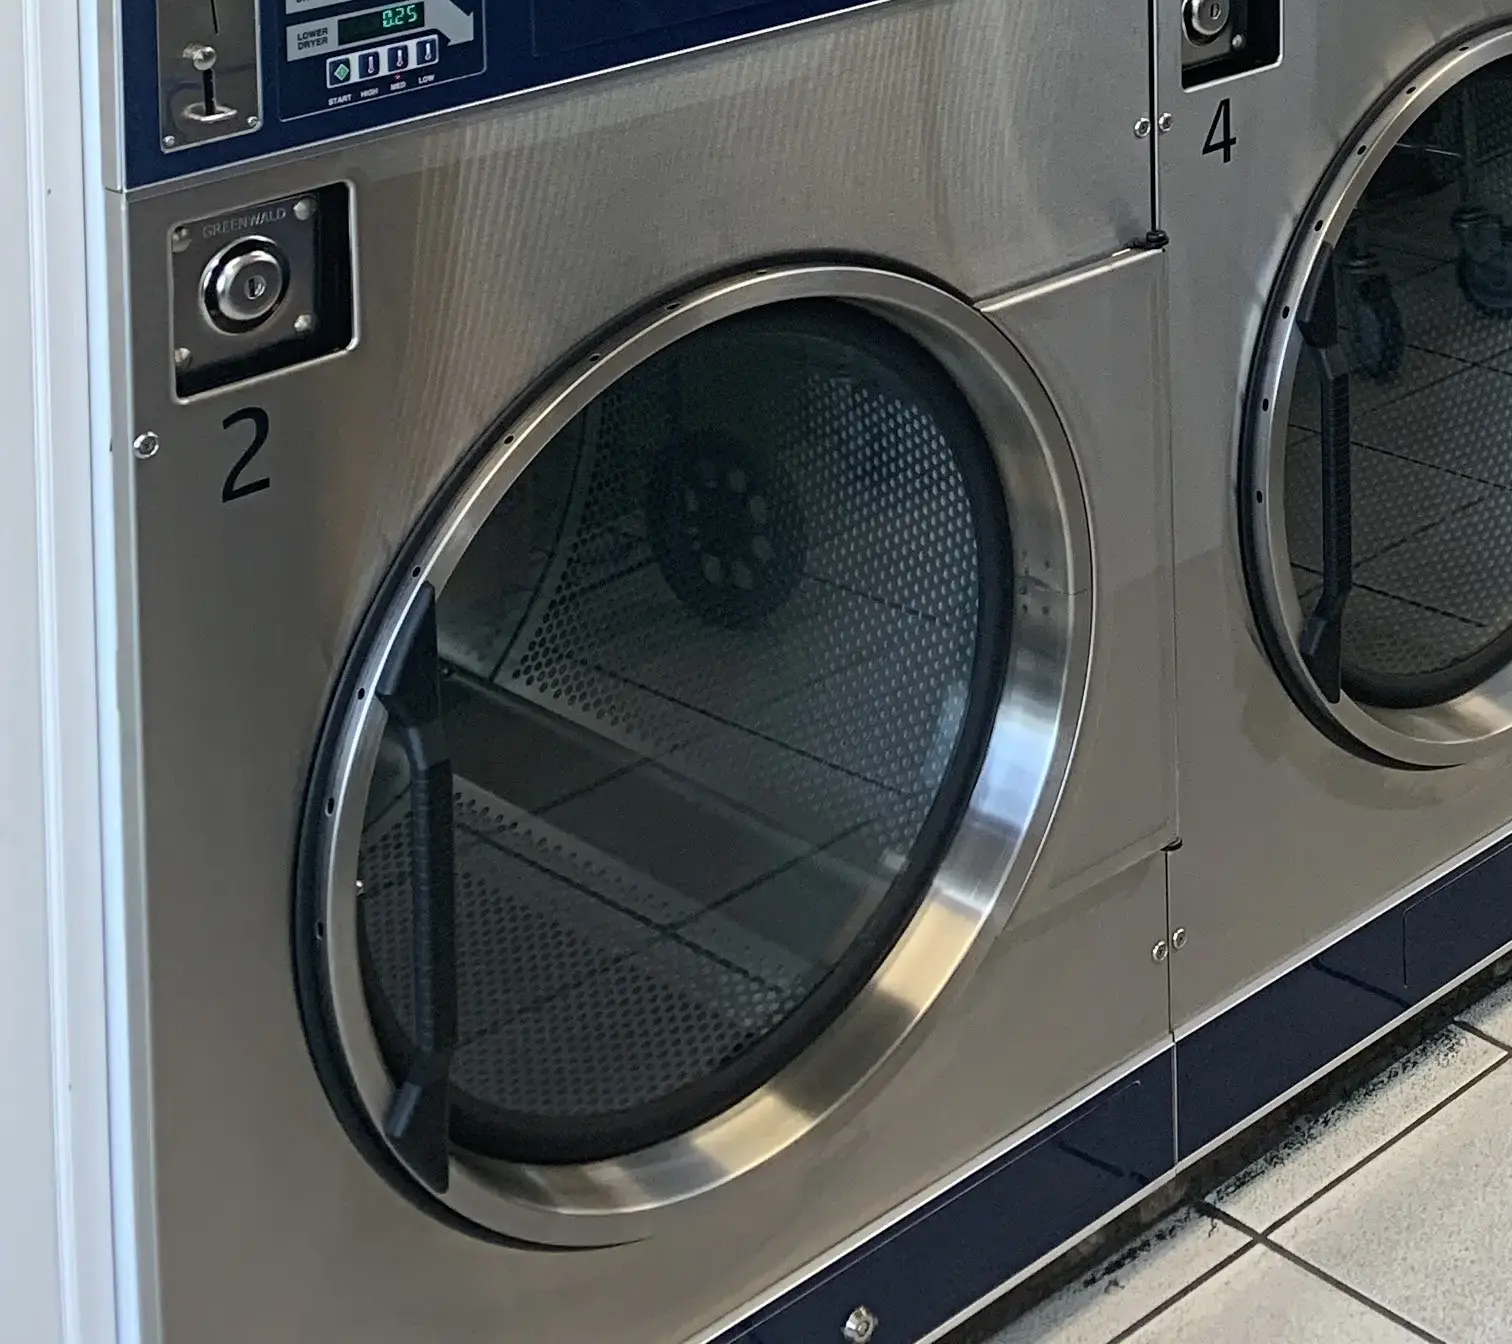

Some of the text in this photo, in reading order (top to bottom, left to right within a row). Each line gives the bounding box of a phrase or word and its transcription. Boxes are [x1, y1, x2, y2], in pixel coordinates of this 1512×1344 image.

[297, 27, 328, 41] LOWER
[297, 36, 328, 51] DRYER
[327, 73, 436, 106] START HIGH MED LOW
[1202, 97, 1237, 164] 4
[202, 207, 287, 239] GREENWALD
[221, 406, 271, 504] 2
